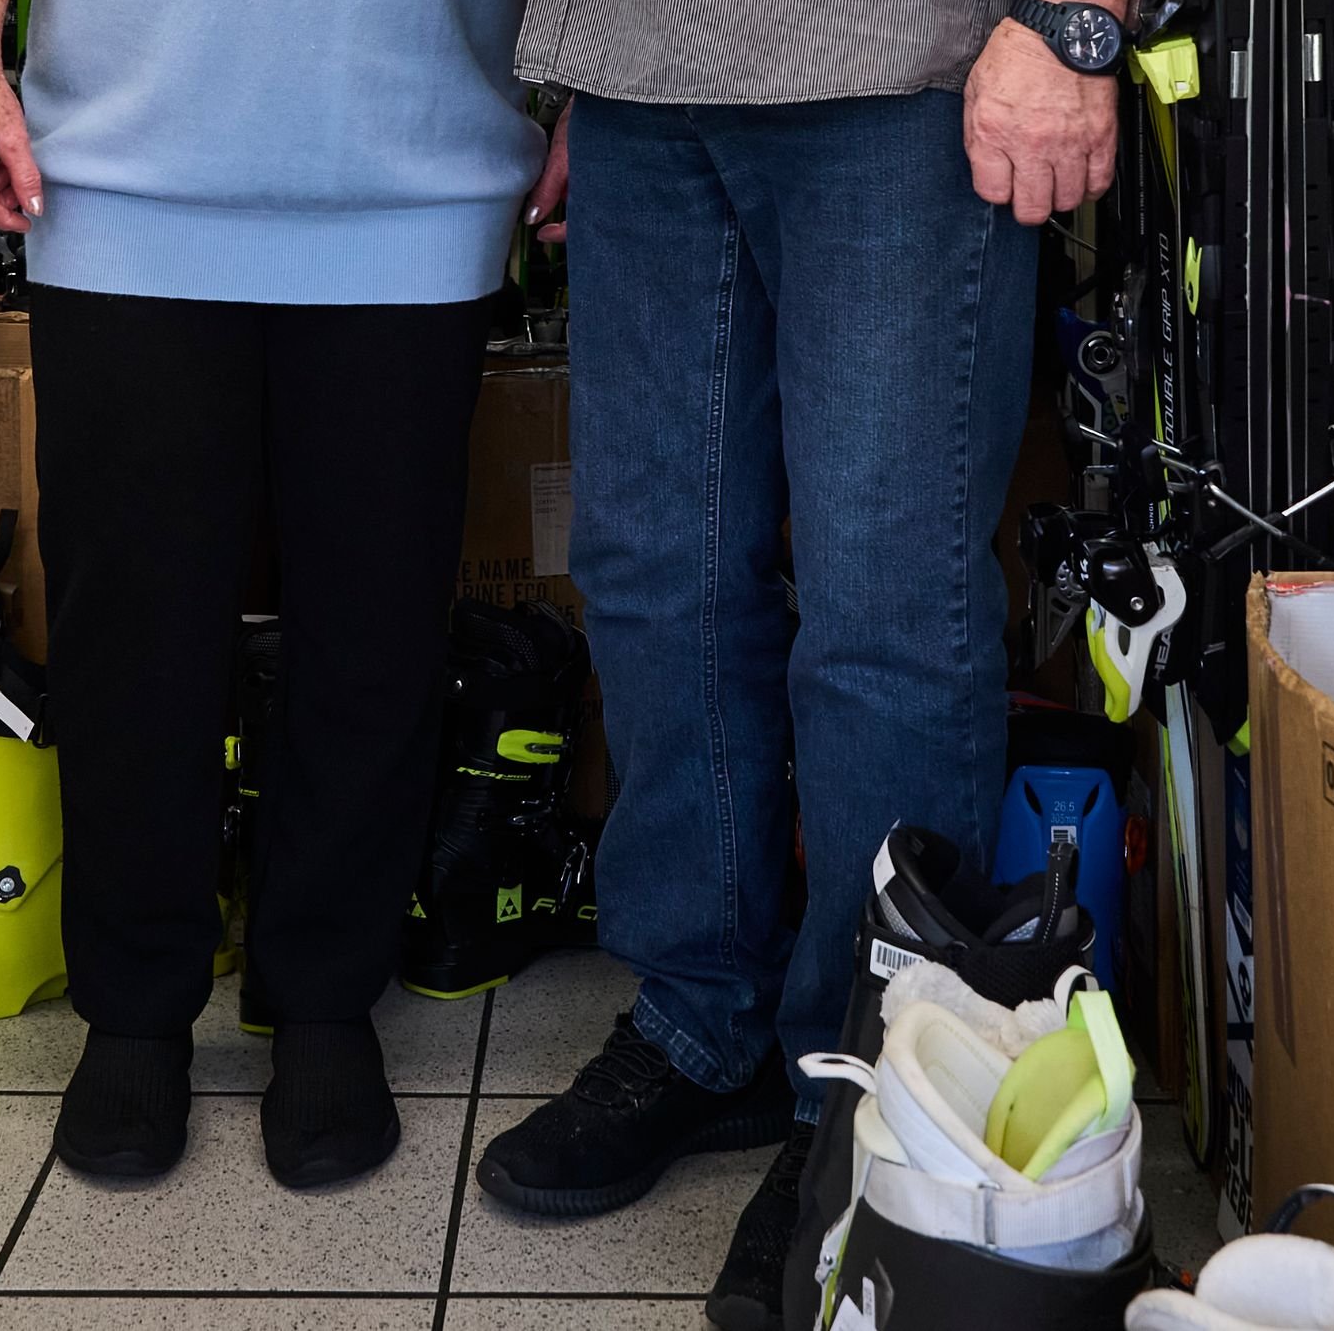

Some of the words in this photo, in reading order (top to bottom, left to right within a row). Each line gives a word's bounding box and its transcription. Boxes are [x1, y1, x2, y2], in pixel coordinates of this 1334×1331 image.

[1157, 231, 1171, 283] XTD
[1160, 287, 1174, 342] GRIP
[1161, 351, 1176, 445] DOUBLE
[478, 557, 531, 582] NAME
[1152, 626, 1174, 682] HEA
